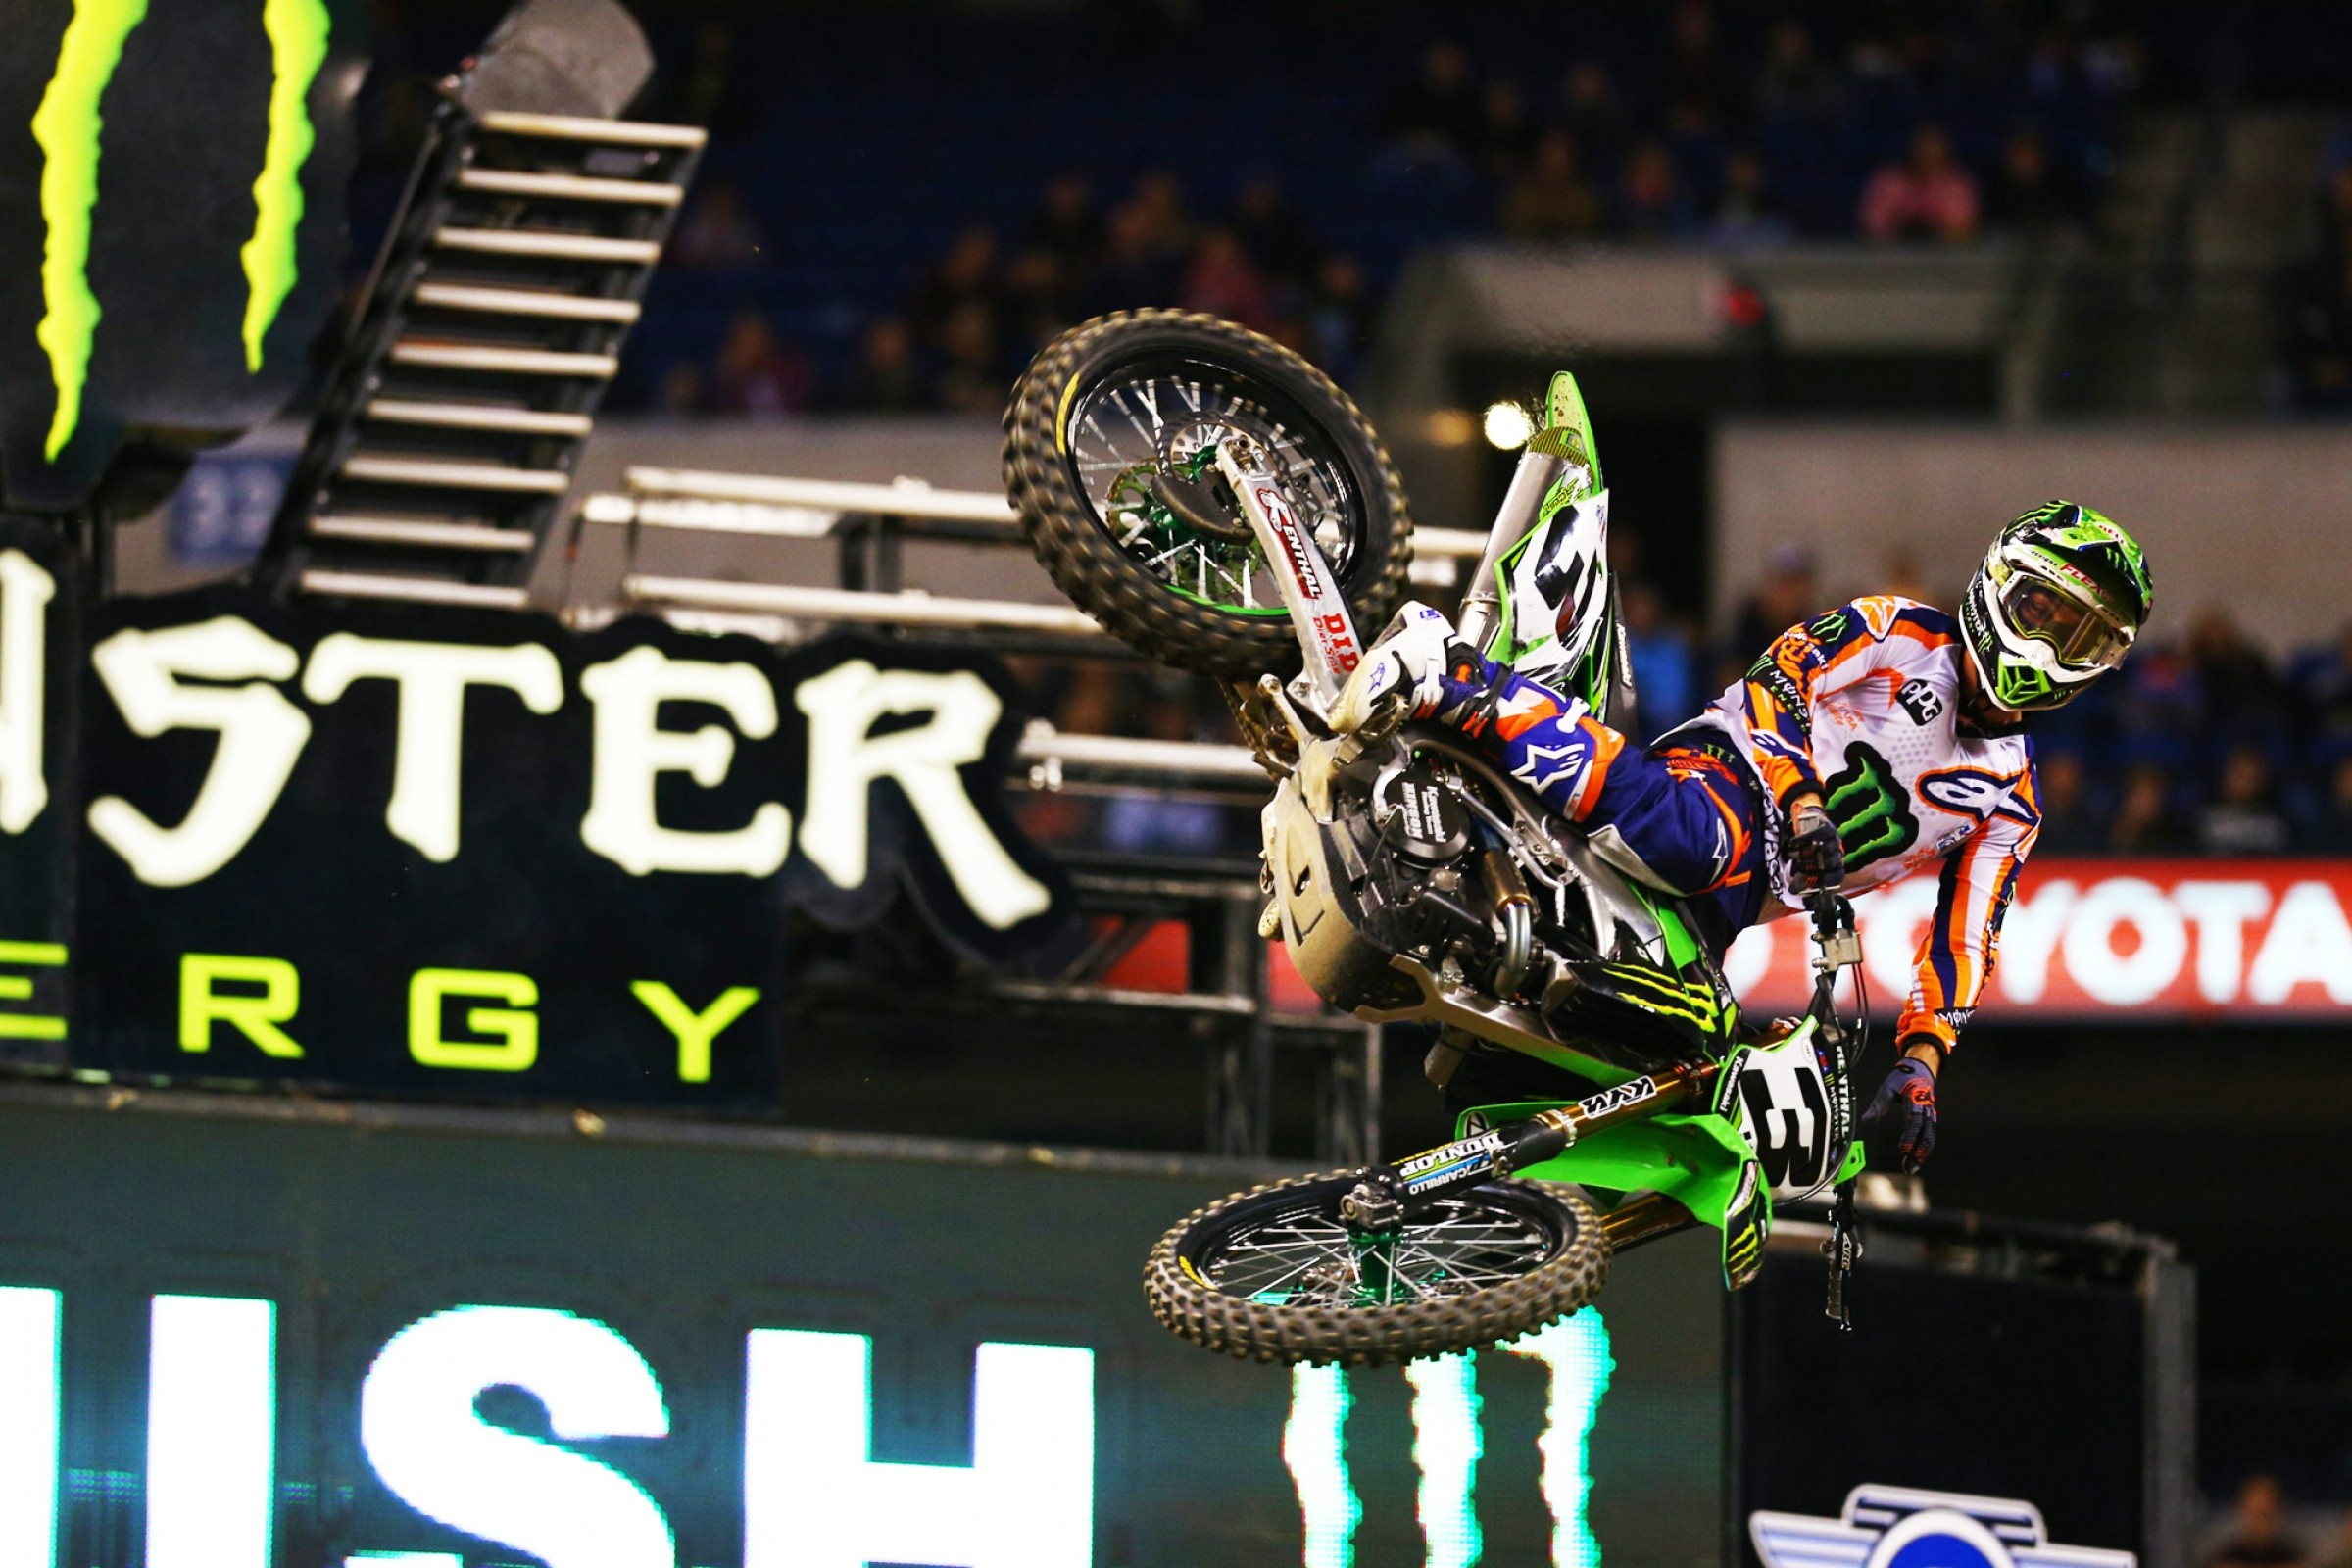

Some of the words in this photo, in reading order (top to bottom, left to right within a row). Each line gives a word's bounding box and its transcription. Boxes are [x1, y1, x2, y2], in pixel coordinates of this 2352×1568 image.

[1257, 489, 1321, 600] RENTHAL
[1769, 669, 1812, 727] MONS
[1901, 681, 1939, 722] PPG
[1719, 1055, 1744, 1113] Kawasaki
[1399, 1132, 1500, 1177] DUNLOP
[1740, 1066, 1829, 1188] 3
[1408, 1167, 1468, 1195] CARRILLO
